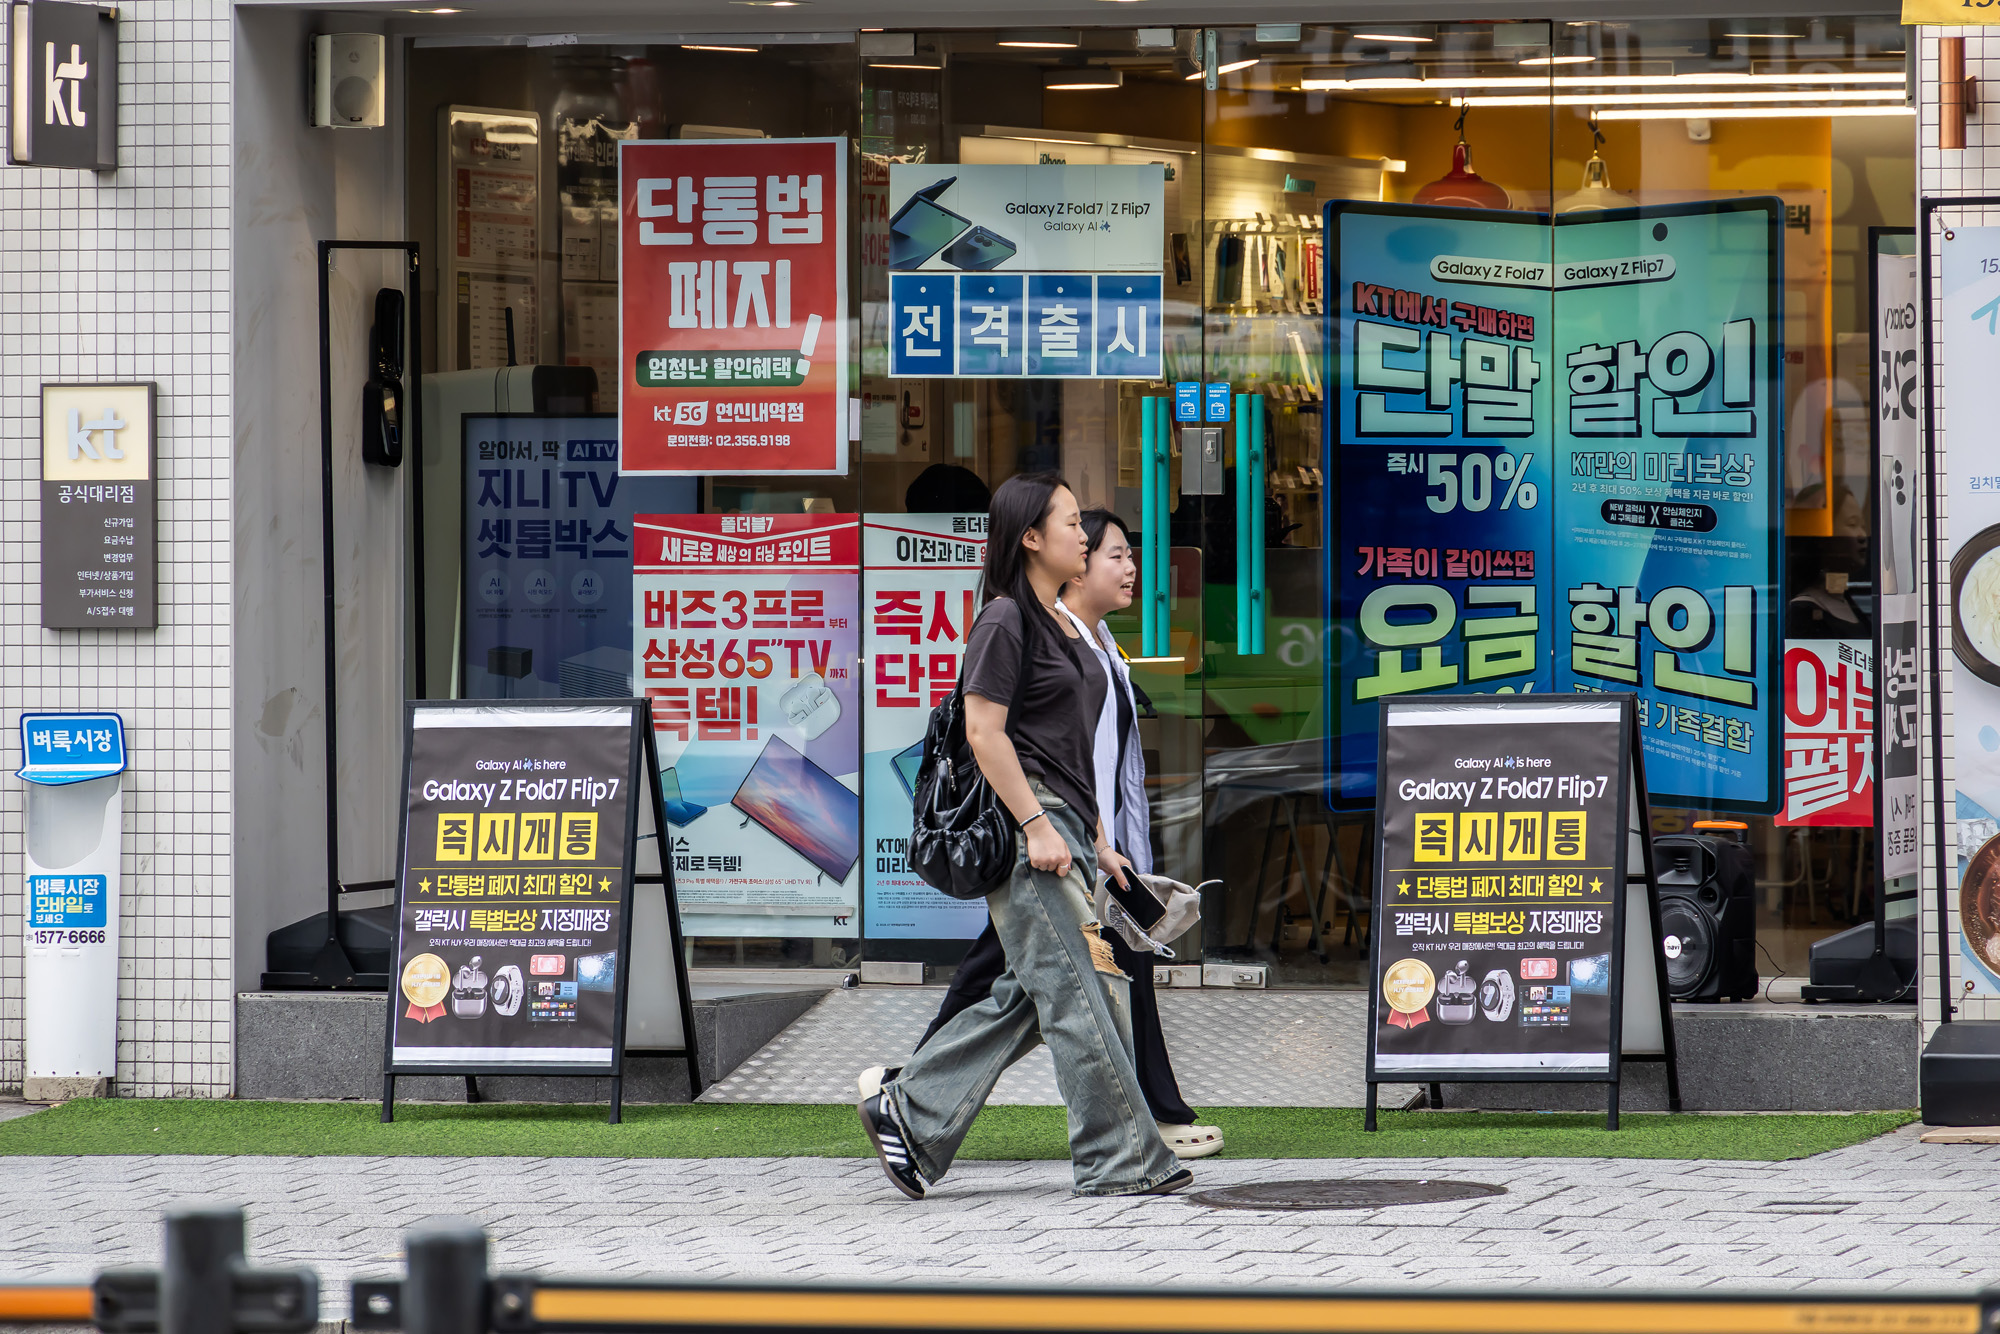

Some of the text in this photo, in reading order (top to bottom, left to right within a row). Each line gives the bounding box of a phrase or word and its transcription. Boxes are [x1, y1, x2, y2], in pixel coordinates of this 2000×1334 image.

[45, 41, 88, 127] kt
[637, 174, 823, 245] 단통법
[1005, 202, 1150, 218] Galaxy Z Fold7 Z Flip7
[1044, 221, 1098, 233] Galaxy AI
[1437, 260, 1545, 281] Galaxy Z Fold7
[1564, 259, 1664, 281] Galaxy Z Flip7
[1353, 281, 1535, 342] KT에서 구매하면
[903, 303, 1147, 358] 전격출시
[648, 357, 791, 380] 엄청난 할인혜택
[1353, 319, 1541, 438] 단말
[1566, 317, 1757, 439] 할인
[653, 402, 804, 423] kt 5G 연신내역점
[67, 407, 126, 460] kt
[667, 434, 790, 448] 문의전화: 02.356.9198
[479, 440, 617, 462] 알아서, 딱 AI TV
[1571, 452, 1755, 487] KT만의 미리보상
[58, 485, 134, 503] 공식대리점
[477, 469, 619, 509] 지니 TV
[1387, 452, 1538, 514] 즉시 50%
[1572, 483, 1754, 502] 2년 후 최대 50% 보상 혜택을 지금 바로 할인!
[1610, 503, 1645, 513] NEW 갤럭시
[1610, 513, 1617, 521] AI
[1662, 507, 1702, 518] 안심체인지
[103, 517, 134, 528] 신규가입
[721, 516, 774, 533] 폴더블7
[1670, 517, 1694, 528] 플러스
[103, 535, 134, 546] 요금수납
[477, 519, 628, 559] 셋톱박스
[660, 535, 831, 563] 새로운 세상의 터닝 포인트
[896, 535, 952, 563] 이전과
[955, 544, 976, 563] 다른
[103, 553, 134, 563] 변경업무
[1357, 546, 1535, 578] 가족이 같이쓰면
[77, 570, 134, 581] 인터넷/상품가입
[489, 578, 500, 587] AI
[535, 578, 546, 587] AI
[582, 578, 593, 587] AI
[79, 588, 134, 598] 부가서비스 신청
[86, 606, 134, 617] A/S접수 대행
[645, 590, 847, 630] 버즈3프로 부터
[874, 590, 974, 645] 즉시
[1355, 584, 1540, 701] 요금
[1568, 582, 1758, 711] 할인
[829, 668, 848, 679] 까지
[644, 686, 758, 742] 득템!
[1656, 702, 1754, 754] 가족결합
[33, 729, 112, 753] 벼룩시장
[476, 759, 566, 773] Galaxy AI is here
[1454, 757, 1551, 771] Galaxy AI is here
[423, 776, 620, 808] Galaxy Z Fold7 Flip7
[1398, 775, 1608, 807] Galaxy Z Fold7 Flip7
[442, 818, 592, 856] 즉시개통
[1420, 818, 1581, 856] 즉시개통
[708, 856, 741, 872] 득템!
[35, 879, 100, 896] 벼룩시장
[437, 873, 592, 896] 단통법 폐지 최대 할인
[1416, 874, 1583, 899] 단통법 폐지 최대 할인
[35, 896, 93, 914] 모바일로
[35, 914, 64, 924] 보세요
[414, 908, 611, 932] 갤럭시 특별보상 지정매장
[1394, 910, 1604, 936] 갤럭시 특별보상 지정매장
[34, 930, 106, 944] 1577-6666
[429, 938, 440, 947] 오직
